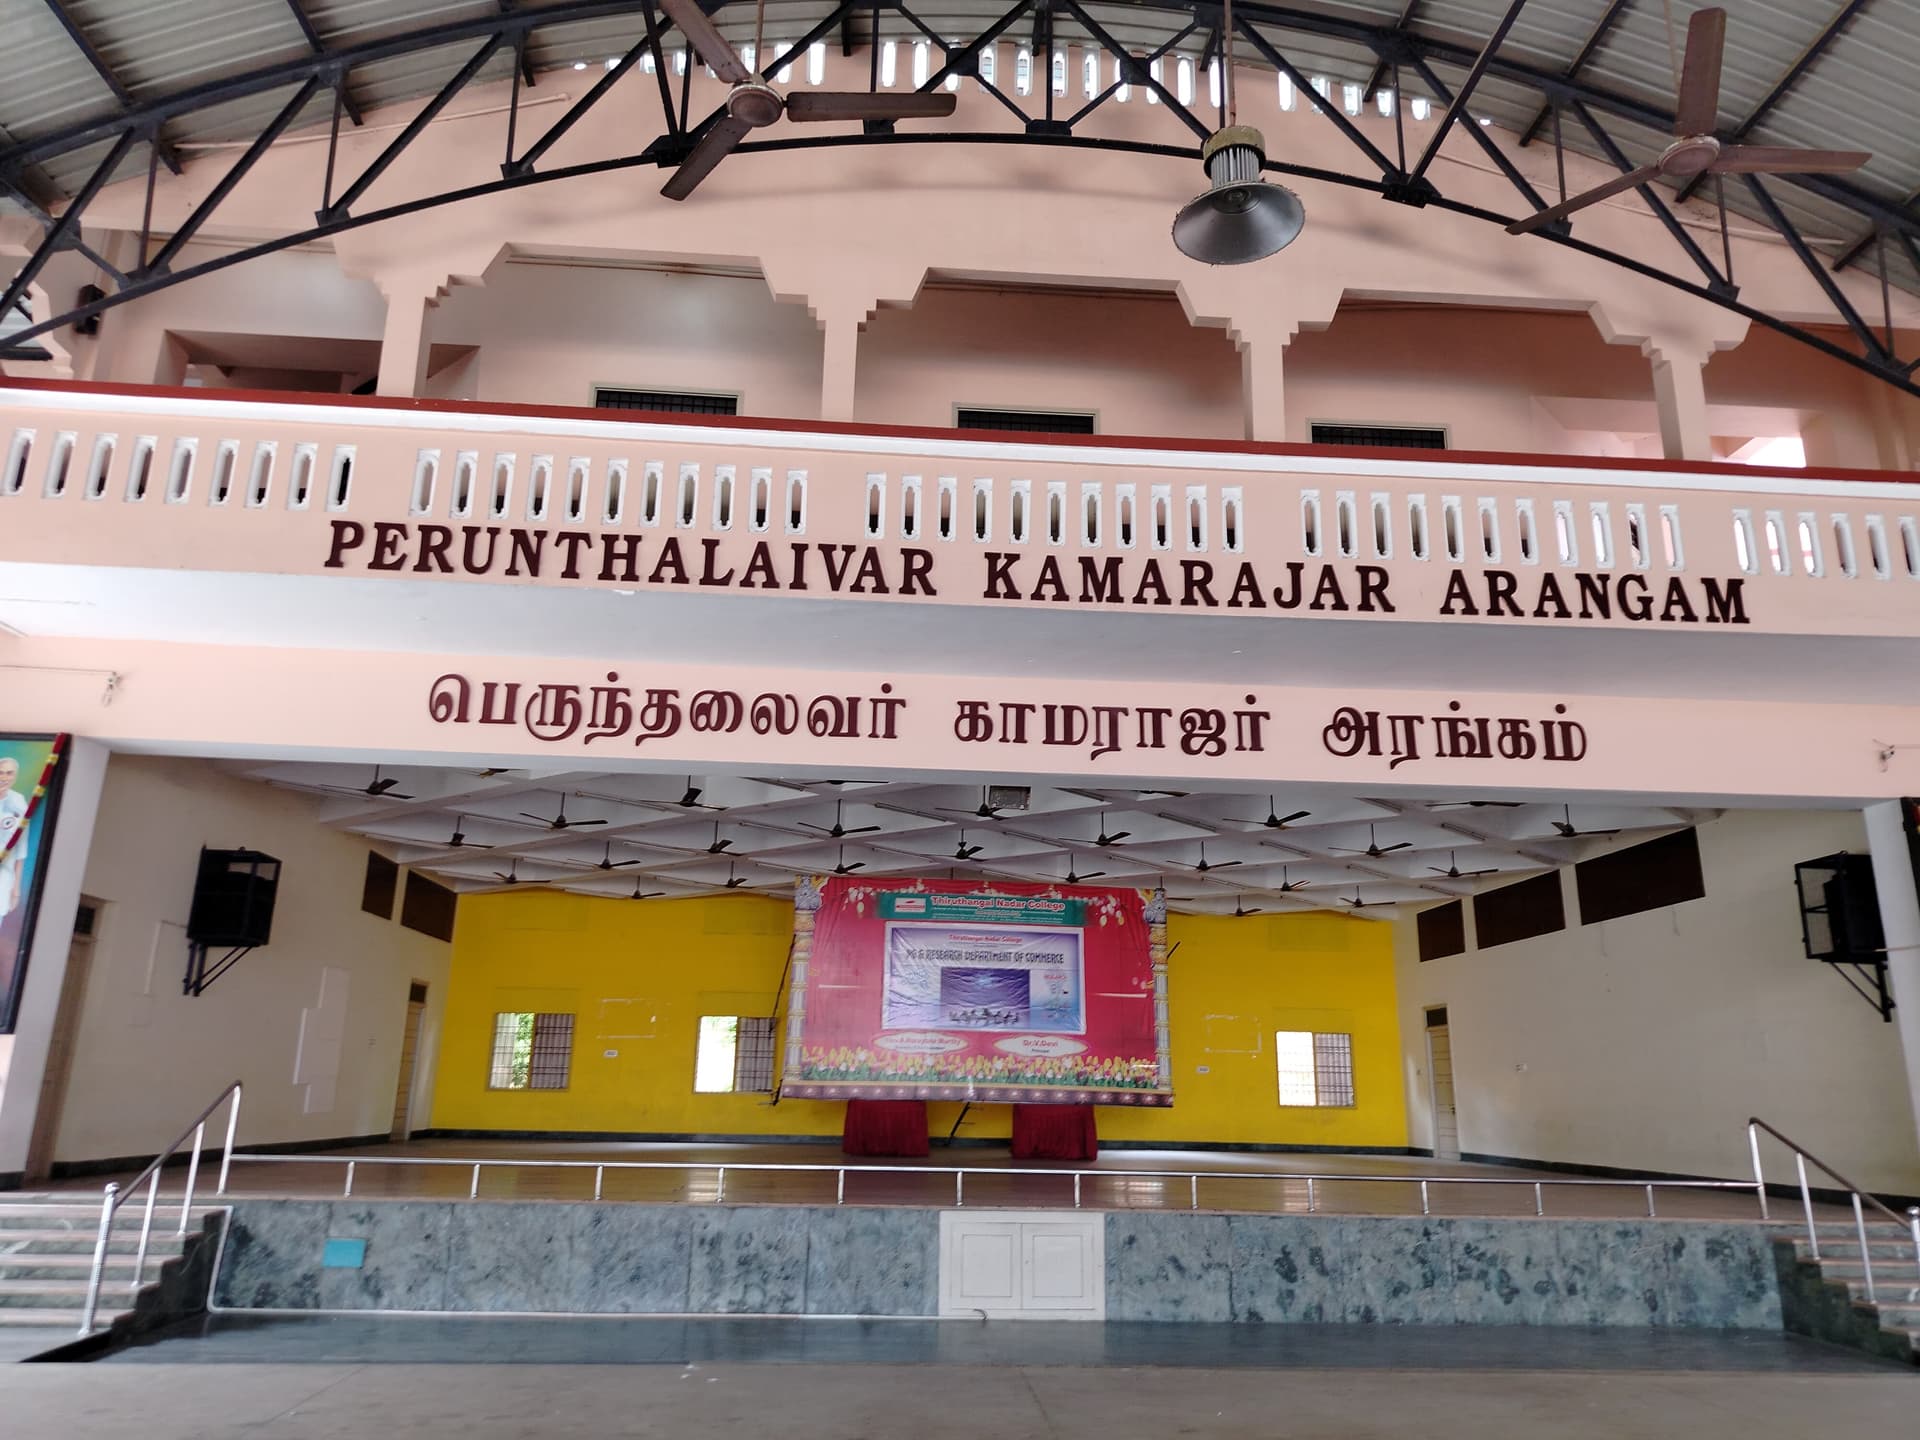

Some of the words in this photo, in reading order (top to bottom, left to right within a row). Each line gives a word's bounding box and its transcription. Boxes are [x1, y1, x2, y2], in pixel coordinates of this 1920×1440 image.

[324, 519, 938, 597] PERUNTHALAIVAR
[983, 551, 1396, 613] KAMARAJAR
[1439, 568, 1751, 625] ARANGAM
[429, 671, 907, 747] பெருந்தலைவர்
[954, 694, 1271, 761] காமராஜர்
[1322, 700, 1587, 770] அரங்கம்
[931, 896, 994, 908] Thiruthangal
[996, 898, 1026, 909] Nadar
[1027, 900, 1065, 911] College
[926, 950, 963, 961] RESEARCH
[965, 951, 1012, 963] DEPARTMENT
[1014, 953, 1024, 963] OF
[1025, 952, 1065, 965] COMMERCE
